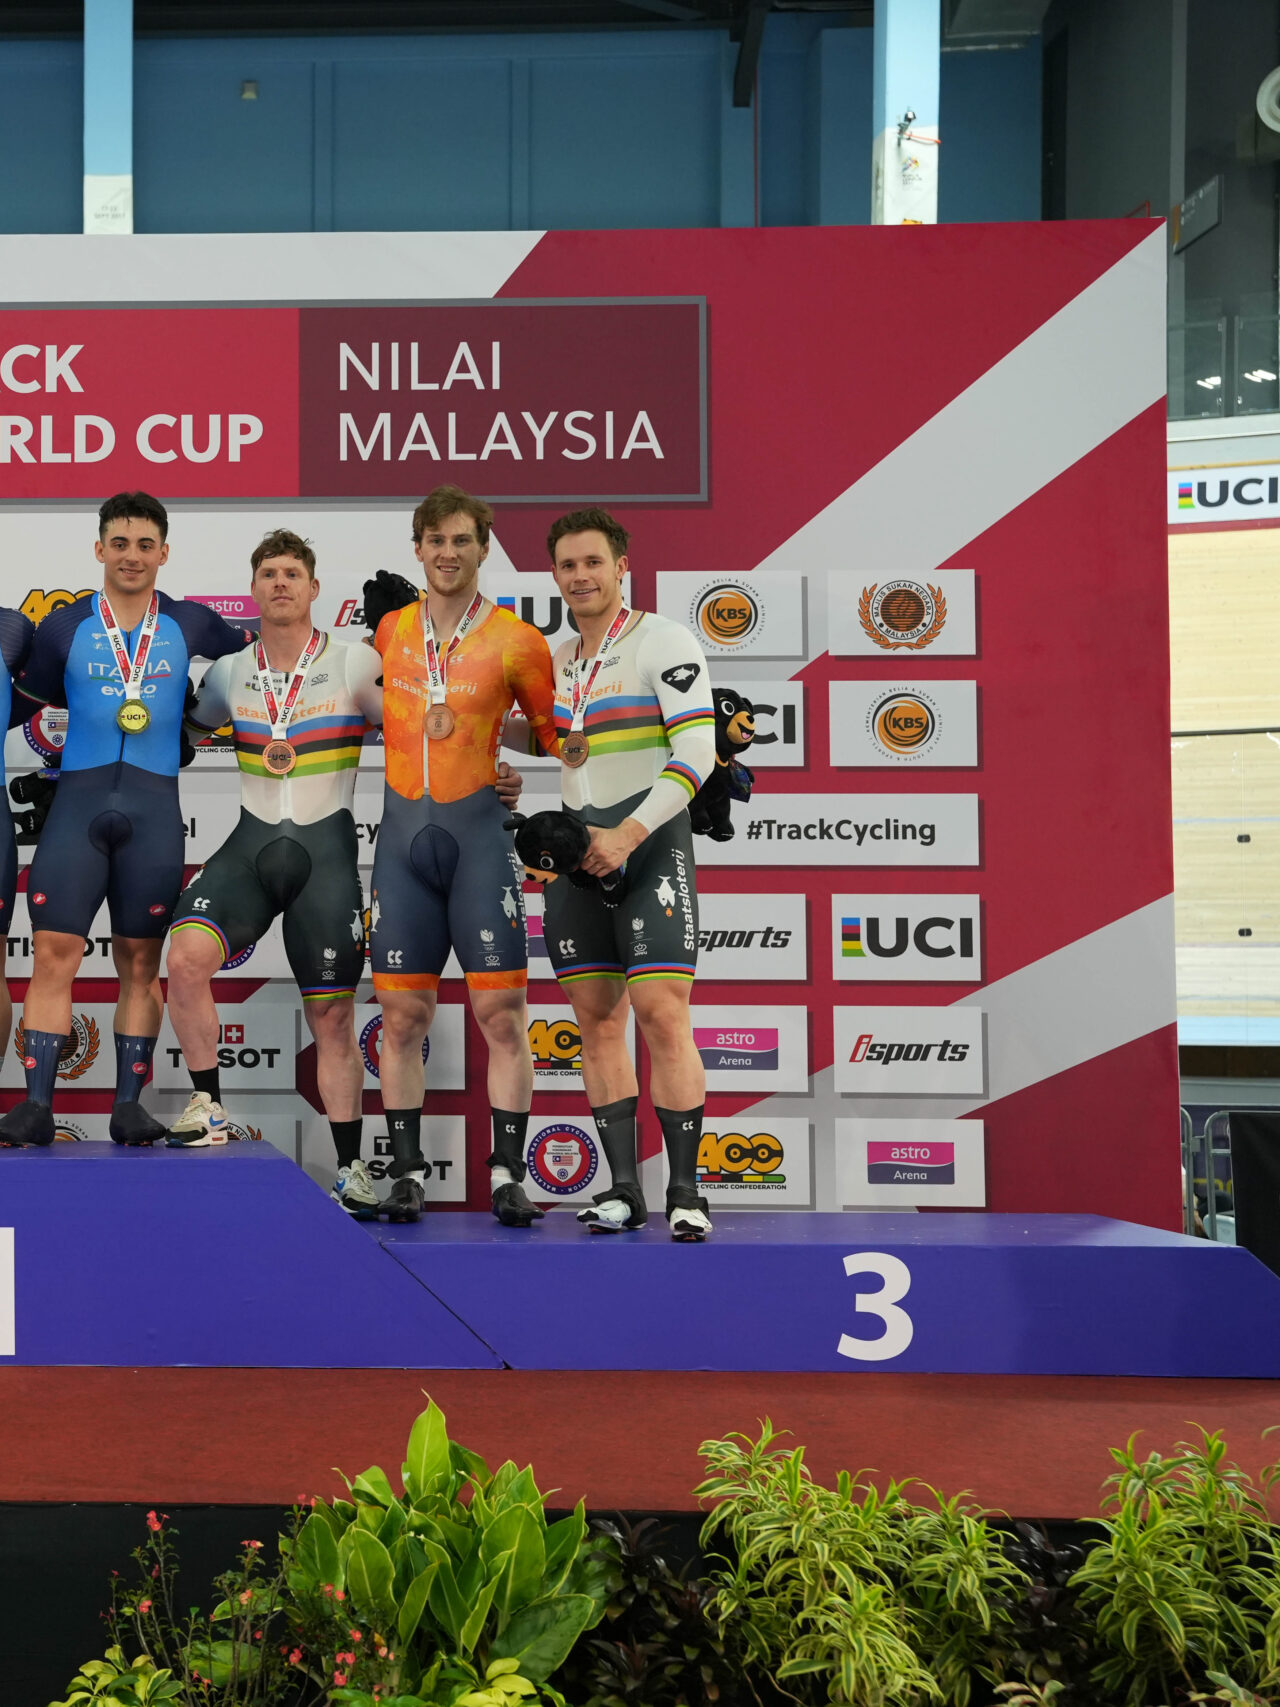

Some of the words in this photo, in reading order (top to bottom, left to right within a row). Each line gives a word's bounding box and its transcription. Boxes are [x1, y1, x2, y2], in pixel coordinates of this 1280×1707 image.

[340, 342, 501, 391] NILAI
[136, 414, 265, 465] CUP
[340, 411, 665, 462] MALAYSIA
[1196, 477, 1280, 507] UCI
[207, 600, 244, 612] astro
[873, 591, 886, 618] MAJLIS
[886, 582, 913, 592] SUKAN
[915, 587, 931, 617] NEGARA
[715, 608, 747, 622] KBS
[885, 627, 922, 639] MALAYSIA
[88, 659, 172, 677] ITAIA
[752, 704, 796, 744] CI
[892, 717, 925, 731] KBS
[746, 818, 936, 846] #TrackCycling
[698, 927, 792, 952] sports
[866, 917, 974, 959] UCI
[716, 1031, 755, 1045] astro
[848, 1033, 970, 1065] isports
[166, 1048, 281, 1068] TSOT
[718, 1055, 752, 1066] Arena
[530, 1126, 561, 1152] NATIONAL
[565, 1126, 594, 1149] CYCLING
[890, 1145, 931, 1159] astro
[528, 1156, 557, 1192] MALAYSIAN
[893, 1169, 928, 1180] Arena
[837, 1252, 915, 1362] 3
